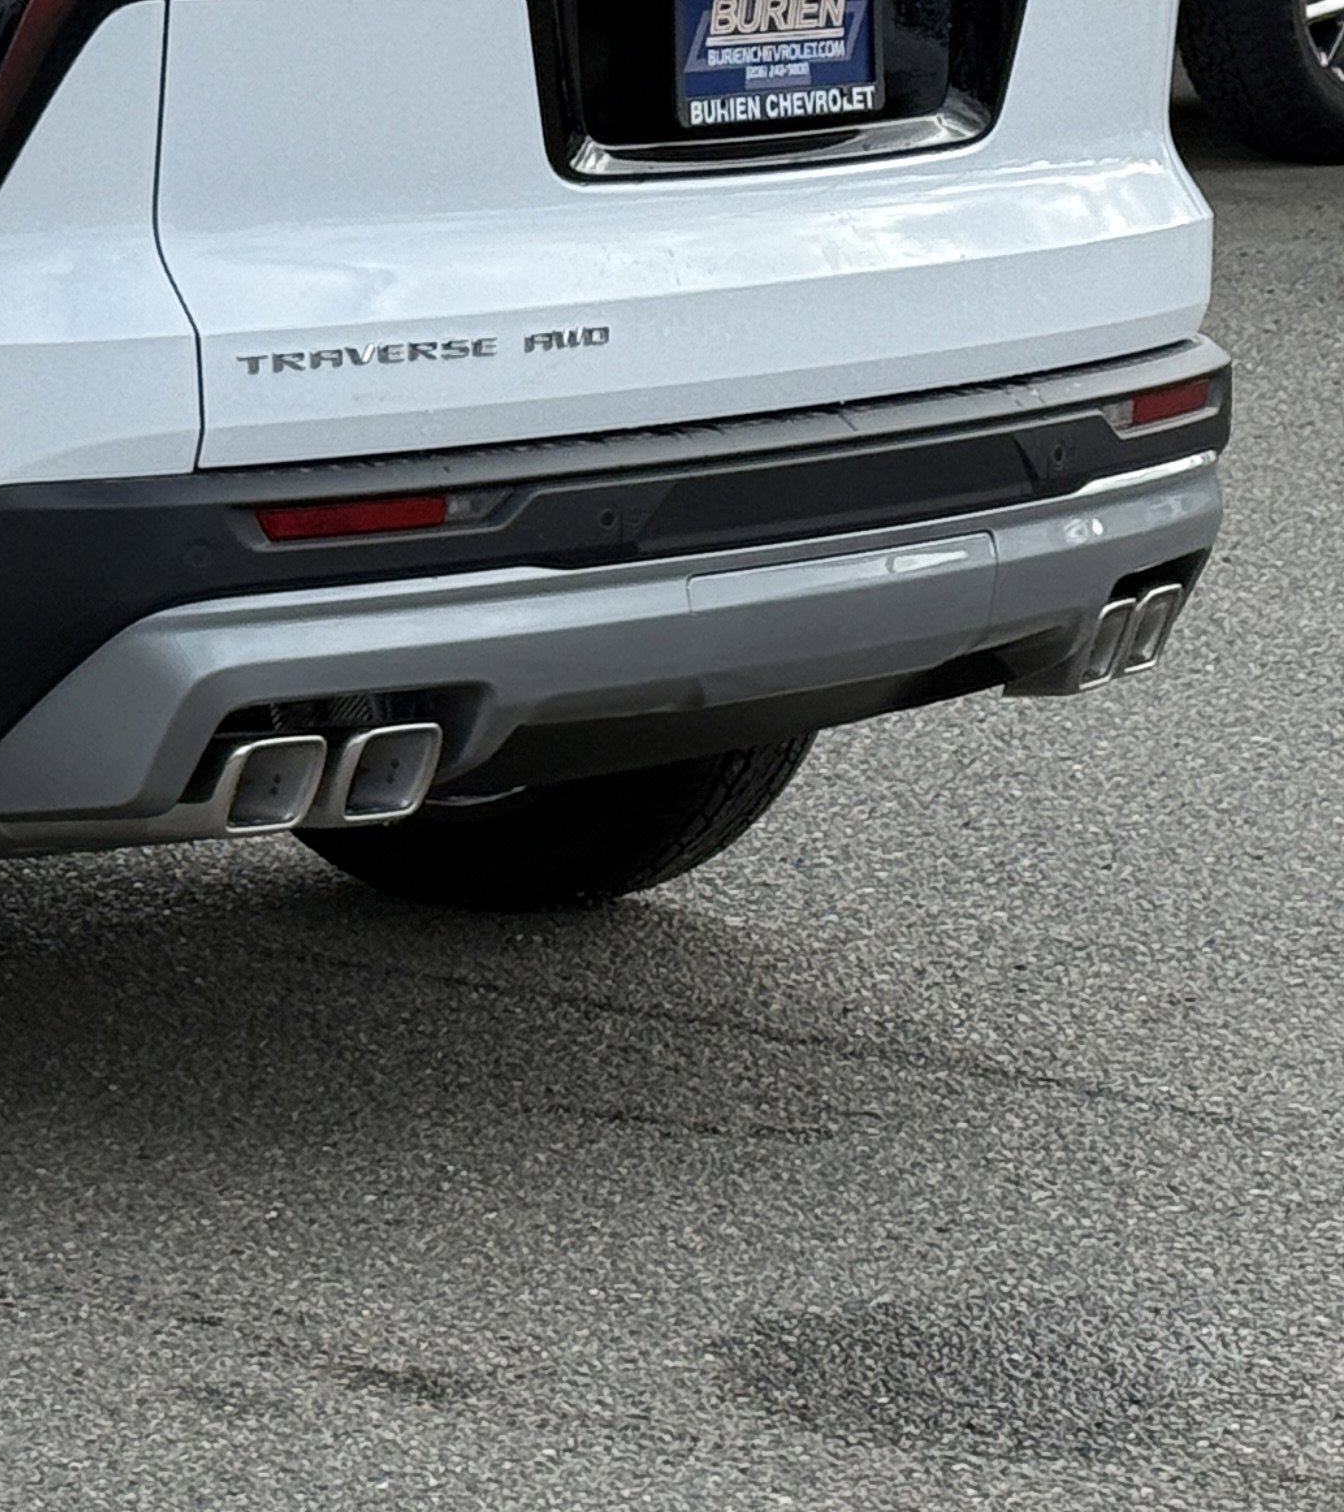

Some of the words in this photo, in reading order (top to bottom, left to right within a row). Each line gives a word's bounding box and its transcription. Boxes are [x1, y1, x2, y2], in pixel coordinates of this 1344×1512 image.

[690, 95, 761, 125] BURIEN
[765, 85, 875, 118] CHEVROLET
[236, 337, 498, 376] TRAVERSE
[524, 325, 610, 353] AWD
